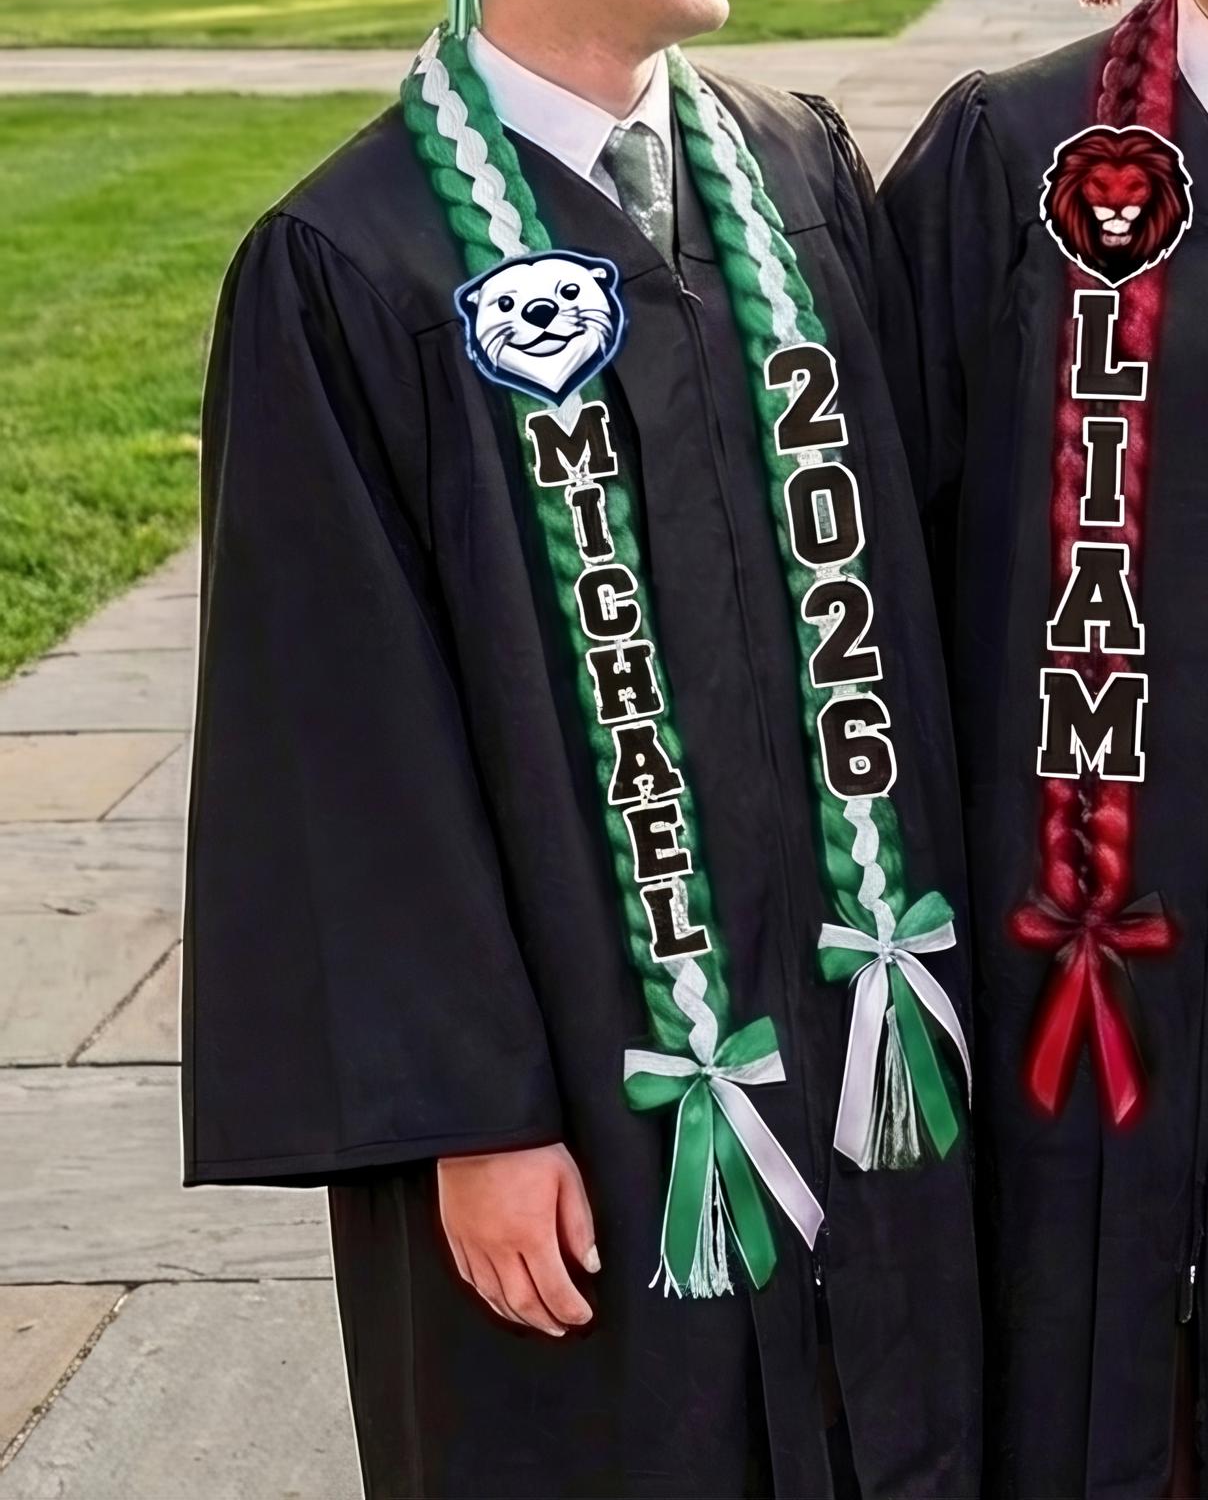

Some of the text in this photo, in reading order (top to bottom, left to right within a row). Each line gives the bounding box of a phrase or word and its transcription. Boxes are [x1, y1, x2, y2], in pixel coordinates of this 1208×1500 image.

[524, 401, 713, 963] MICHAEL
[764, 342, 898, 800] 2026
[1036, 289, 1149, 783] LIAM
